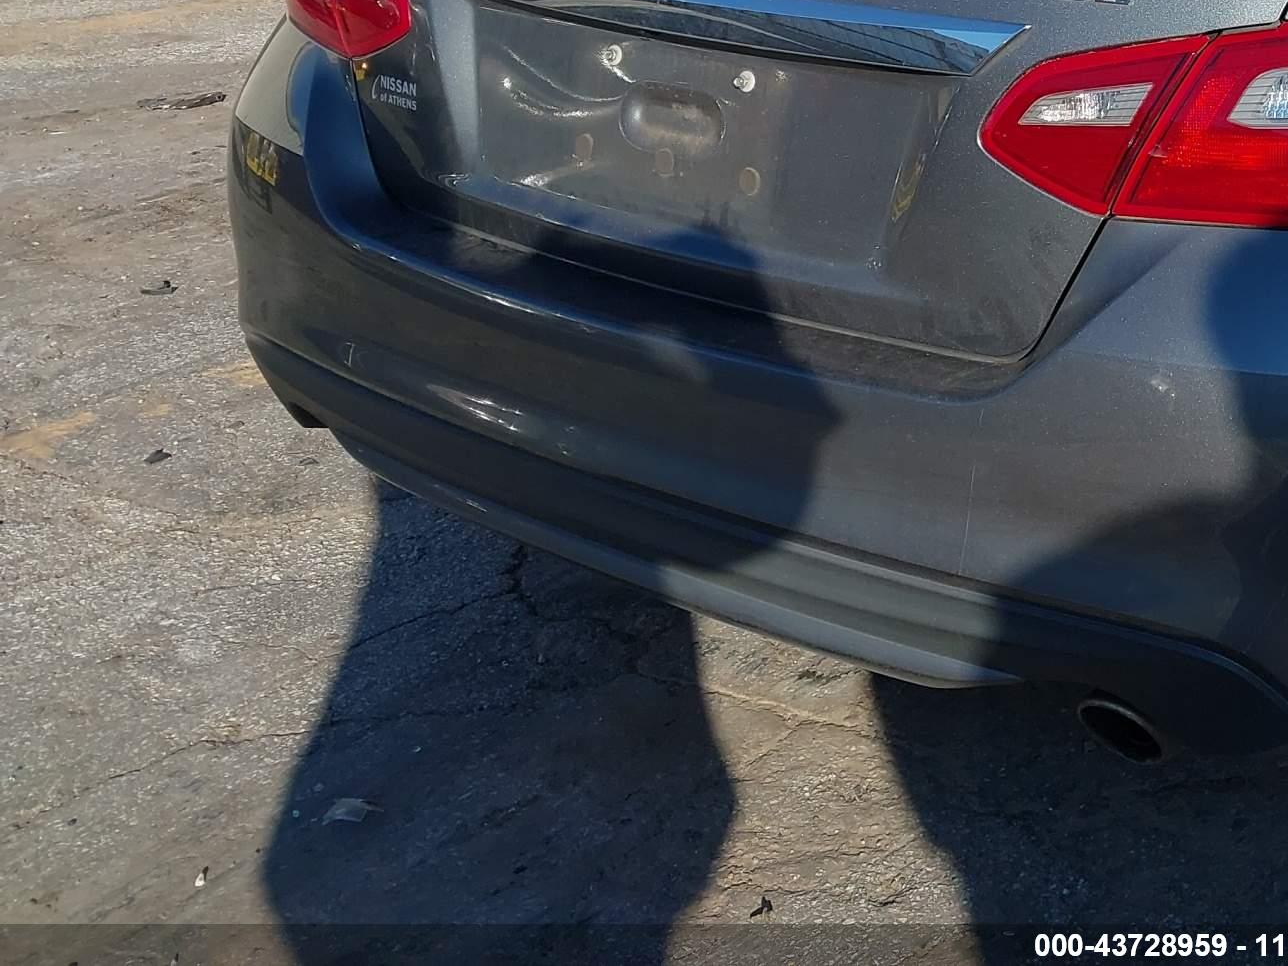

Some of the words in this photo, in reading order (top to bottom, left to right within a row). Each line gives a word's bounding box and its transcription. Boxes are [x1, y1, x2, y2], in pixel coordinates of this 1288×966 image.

[380, 75, 417, 96] NISSAN
[380, 93, 388, 102] of
[388, 95, 417, 111] ATHENS
